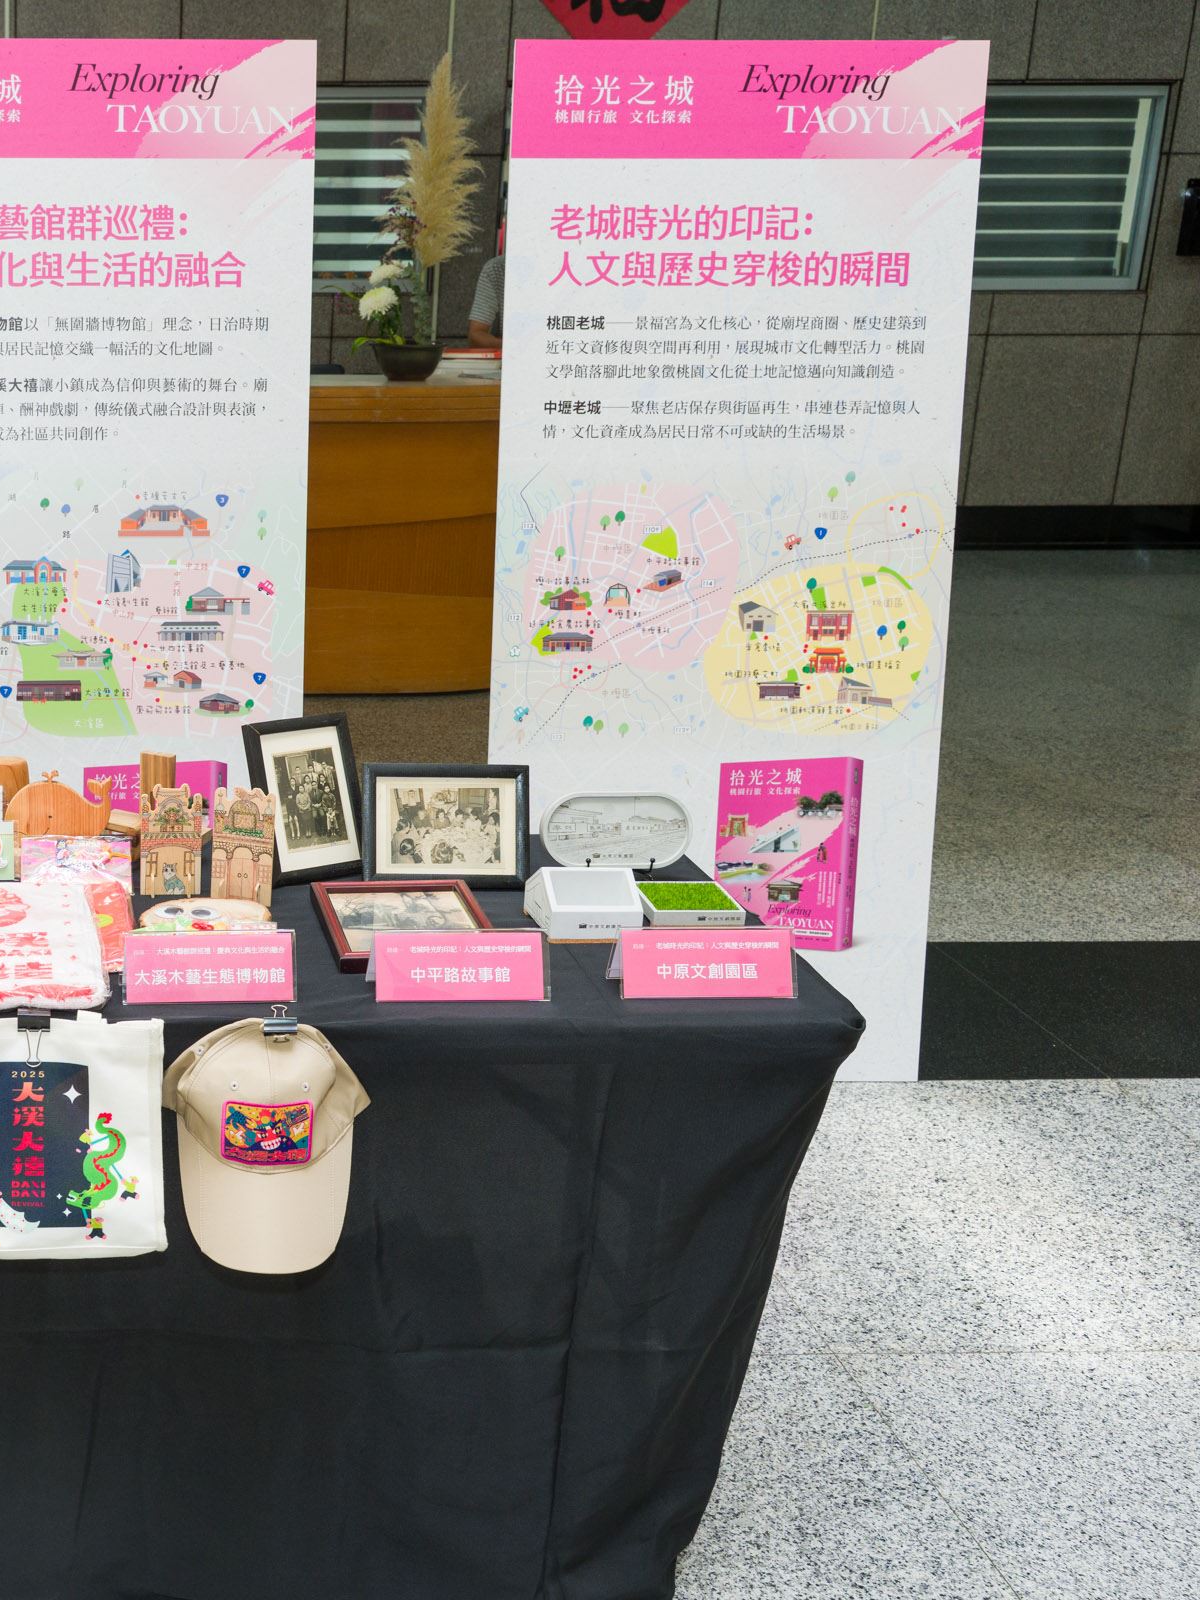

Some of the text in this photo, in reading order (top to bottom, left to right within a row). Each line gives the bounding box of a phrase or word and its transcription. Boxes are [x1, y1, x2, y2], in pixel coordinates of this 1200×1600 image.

[67, 63, 220, 100] Exploring
[554, 75, 694, 105] 拾光之城
[739, 64, 891, 100] Exploring
[107, 104, 298, 134] TAOYUAN
[555, 110, 692, 124] 桃園行旅 文化探索
[776, 105, 967, 135] TAOYUAN
[550, 204, 814, 241] 老城時光的印記：
[548, 251, 910, 288] 人文與歷史穿梭的瞬間
[729, 768, 802, 787] 拾光之城
[767, 903, 812, 916] Exploring
[778, 916, 834, 930] TAOYUAN
[134, 967, 286, 986] 大溪木藝生態博物館
[411, 966, 511, 984] 中平路故事館
[657, 962, 759, 980] 中原文創園區
[11, 1070, 45, 1078] 2025
